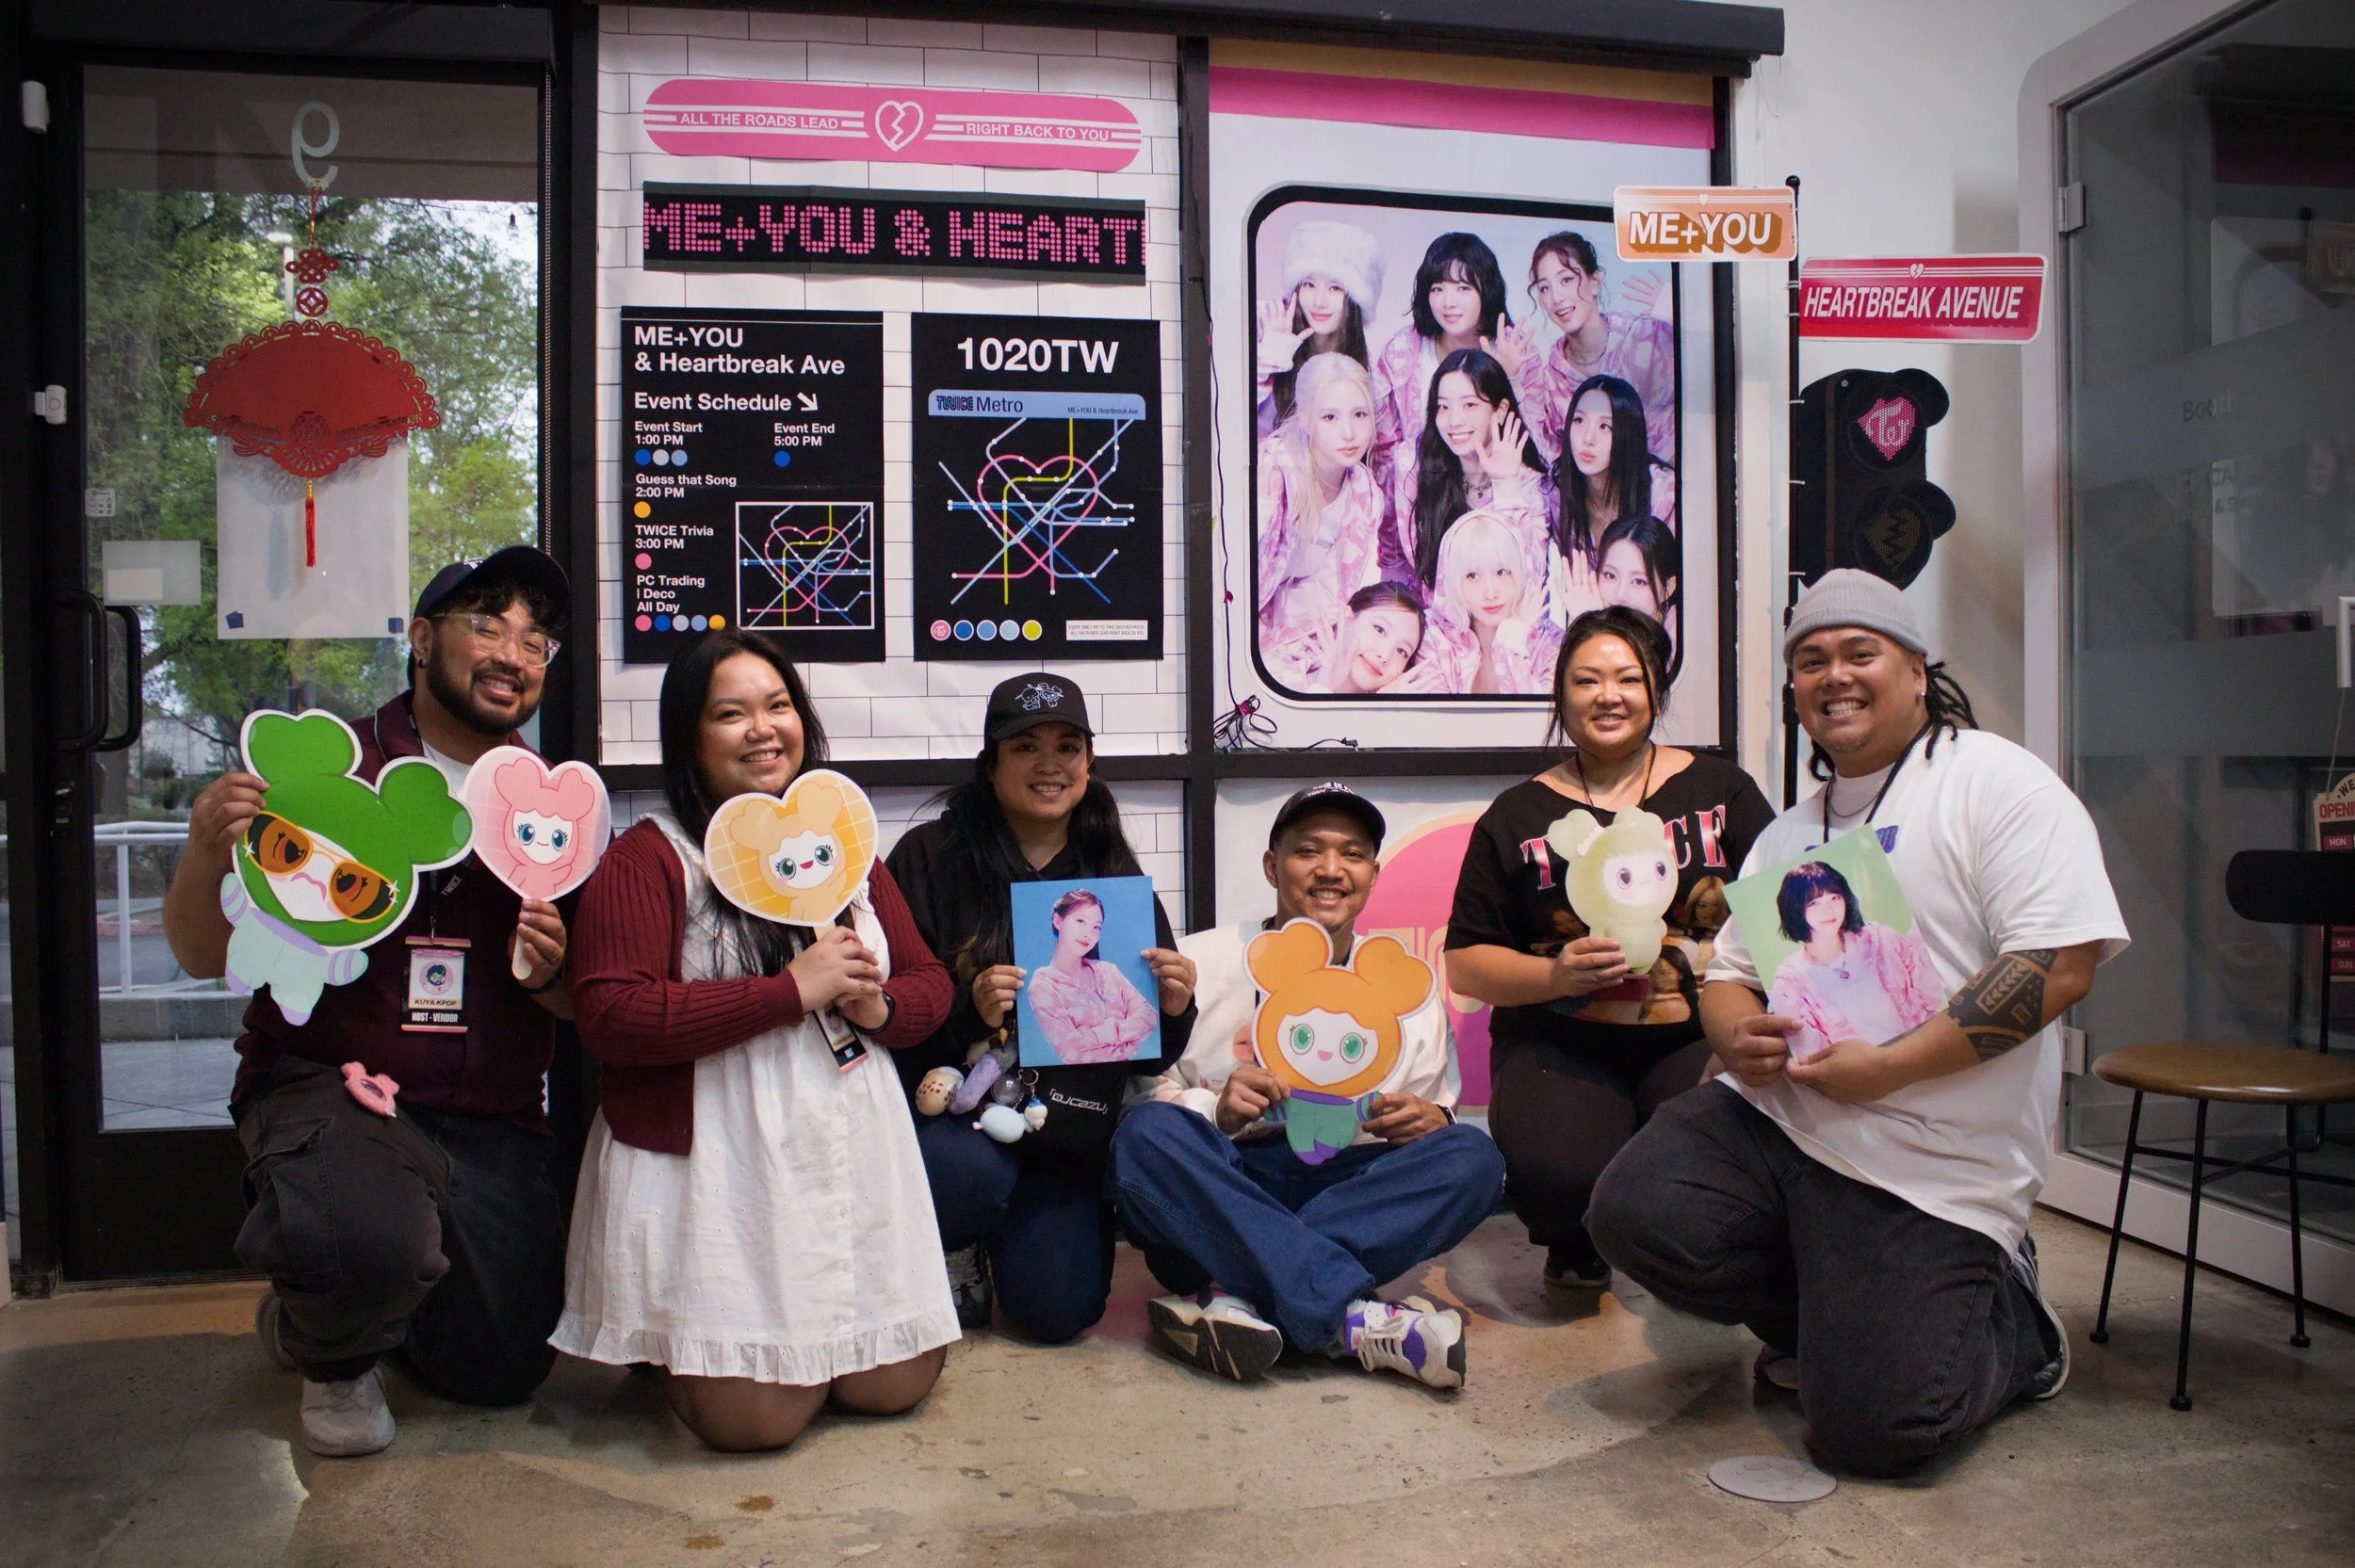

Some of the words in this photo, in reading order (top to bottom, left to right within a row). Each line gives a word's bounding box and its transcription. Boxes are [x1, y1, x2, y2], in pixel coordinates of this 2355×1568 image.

[680, 112, 707, 125] ALL
[712, 113, 740, 126] THE
[745, 114, 797, 128] ROADS
[801, 116, 839, 130] LEAD
[966, 122, 1010, 136] RIGHT
[1014, 124, 1053, 138] BACK
[1056, 126, 1076, 139] TO
[1080, 128, 1110, 141] YOU
[643, 202, 875, 254] ME+YOU
[895, 209, 930, 256] &
[950, 210, 1145, 266] HEART
[1629, 213, 1772, 246] ME+YOU
[1804, 286, 1937, 318] HEARTBREAK
[1936, 286, 2024, 319] AVENUE
[635, 327, 743, 348] ME+YOU
[957, 337, 1119, 374] 1020TW
[635, 352, 652, 371] &
[660, 352, 794, 374] Heartbreak
[801, 355, 845, 374] Ave
[635, 393, 691, 410] Event
[698, 393, 791, 411] Schedule
[977, 396, 1023, 412] Metro
[1097, 407, 1128, 415] Heartbreak
[635, 421, 671, 432] Event
[674, 422, 703, 433] Start
[774, 423, 808, 433] Event
[812, 423, 835, 434] End
[635, 434, 660, 445] 1:00
[663, 435, 683, 445] PM
[774, 436, 801, 446] 5:00
[804, 436, 822, 446] PM
[636, 474, 674, 485] Guess
[678, 474, 702, 485] that
[706, 475, 737, 488] Song
[636, 487, 660, 497] 2:00
[664, 488, 684, 498] PM
[636, 525, 676, 536] TWICE
[680, 525, 713, 536] Trivia
[636, 539, 660, 549] 3:00
[663, 539, 684, 549] PM
[637, 575, 655, 586] PC
[658, 575, 705, 589] Trading
[642, 589, 675, 599] Deco
[637, 602, 653, 612] All
[656, 602, 679, 614] Day
[1519, 803, 1727, 890] TCE
[2330, 838, 2347, 847] MON
[2337, 940, 2350, 948] SAT
[412, 1012, 429, 1022] HOST
[433, 1013, 458, 1023] VENDOR
